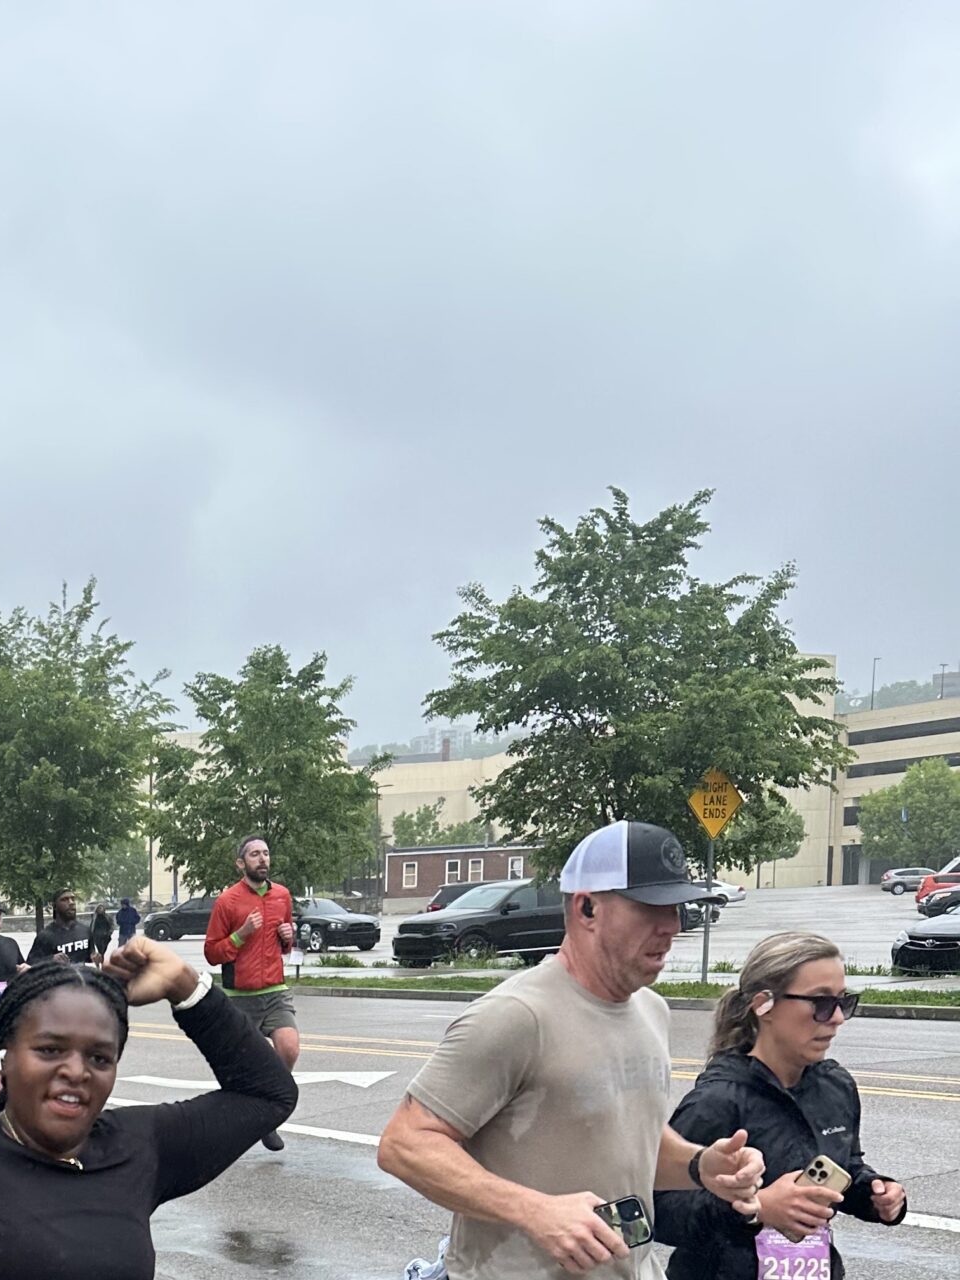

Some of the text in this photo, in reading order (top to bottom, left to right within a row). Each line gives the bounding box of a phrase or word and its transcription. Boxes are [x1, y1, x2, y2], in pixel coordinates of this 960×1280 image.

[703, 795, 728, 805] LANE
[703, 808, 727, 818] ENDS
[763, 1256, 830, 1280] 21225
